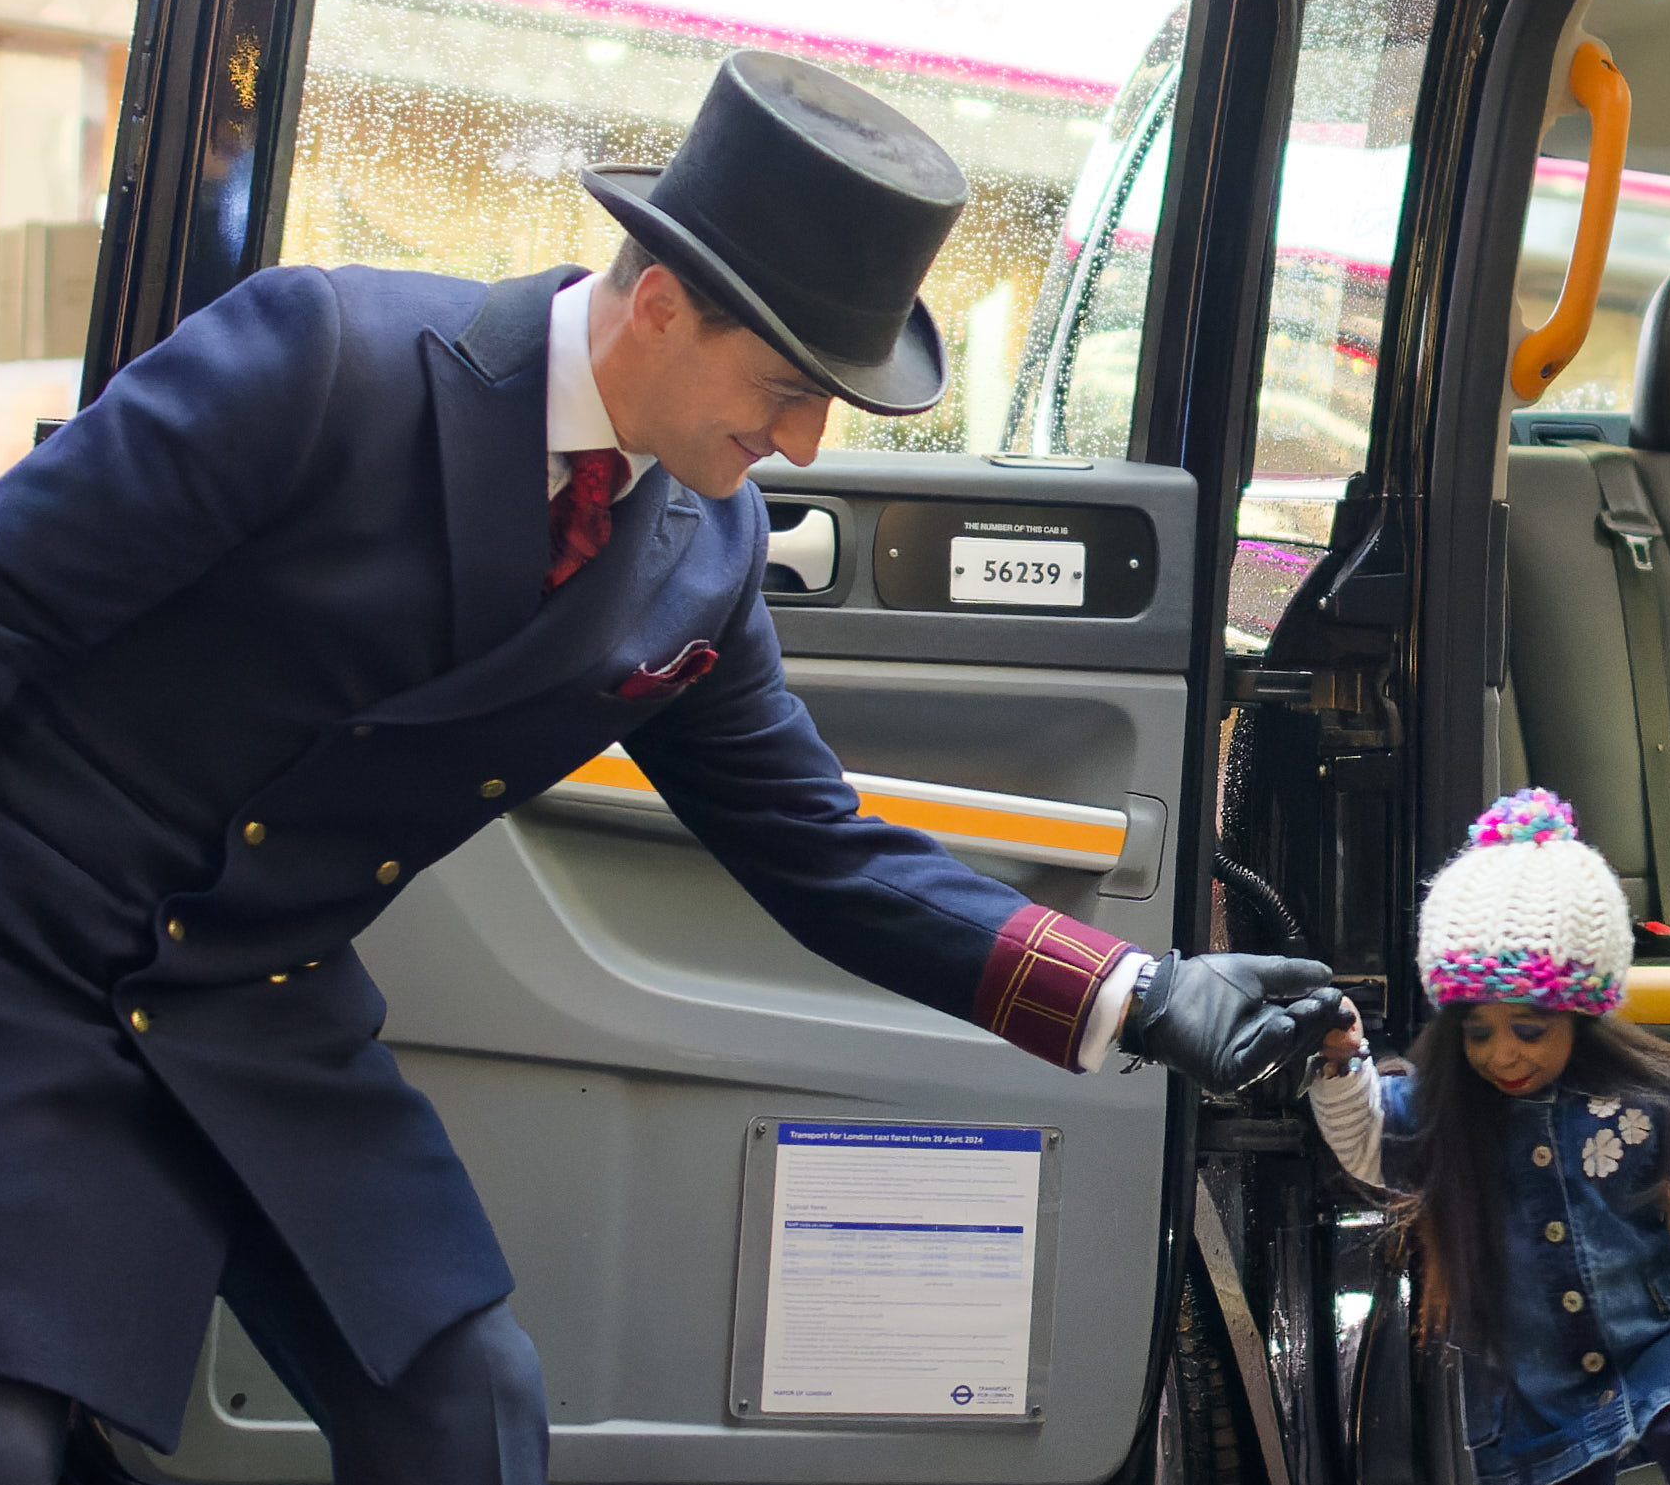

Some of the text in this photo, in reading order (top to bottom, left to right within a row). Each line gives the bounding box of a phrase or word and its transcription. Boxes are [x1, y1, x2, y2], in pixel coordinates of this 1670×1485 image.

[964, 522, 1068, 535] THE NUMBER OF THIS CAB IS
[983, 560, 1061, 585] 56239
[790, 1130, 828, 1140] Transport
[830, 1132, 841, 1140] for
[891, 1134, 910, 1142] fares
[944, 1135, 963, 1145] April
